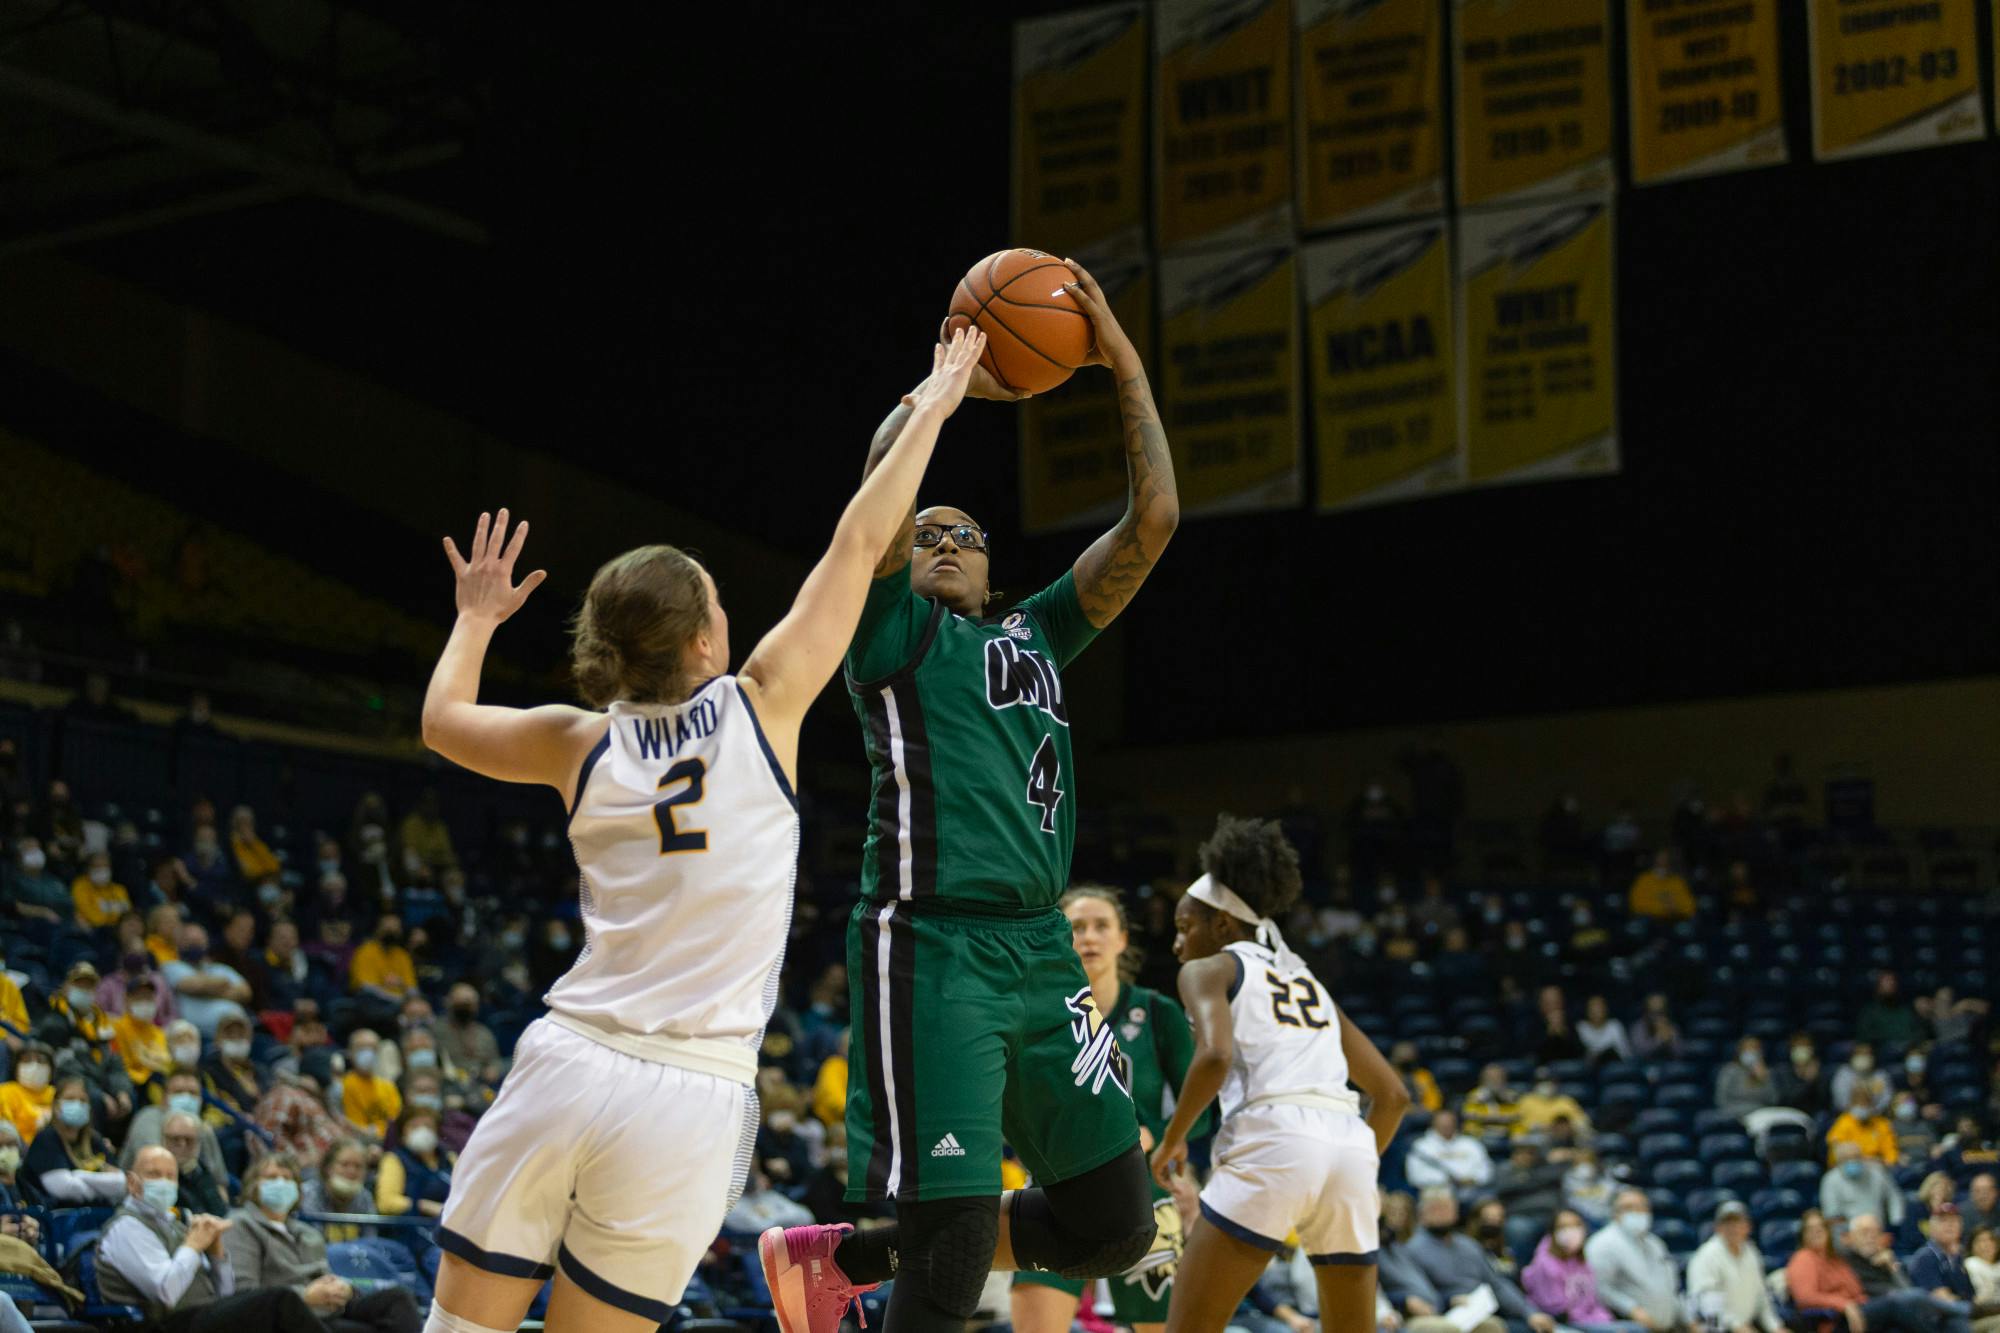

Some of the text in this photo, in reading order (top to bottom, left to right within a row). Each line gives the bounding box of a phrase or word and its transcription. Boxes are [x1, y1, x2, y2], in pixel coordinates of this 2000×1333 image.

[1833, 47, 1959, 95] 2002-03
[1327, 314, 1435, 377] NCAA
[652, 756, 710, 858] 2
[1027, 732, 1065, 835] 4
[1264, 967, 1331, 1031] 22
[931, 1147, 966, 1157] adidas
